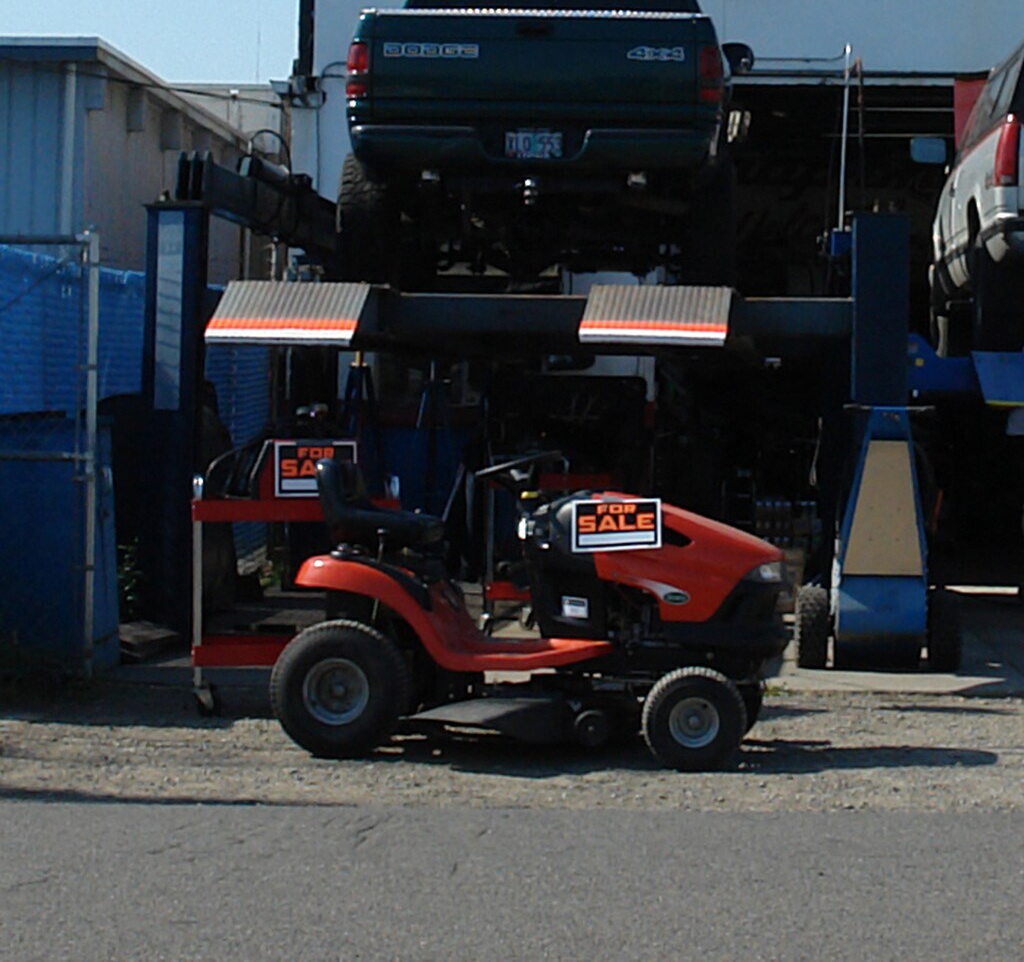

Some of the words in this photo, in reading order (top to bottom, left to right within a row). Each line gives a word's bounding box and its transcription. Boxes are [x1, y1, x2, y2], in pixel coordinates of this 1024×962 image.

[384, 42, 479, 58] DODGE
[297, 447, 334, 459] FOR
[281, 459, 316, 477] SA
[597, 504, 636, 515] FOR
[578, 513, 655, 533] SALE
